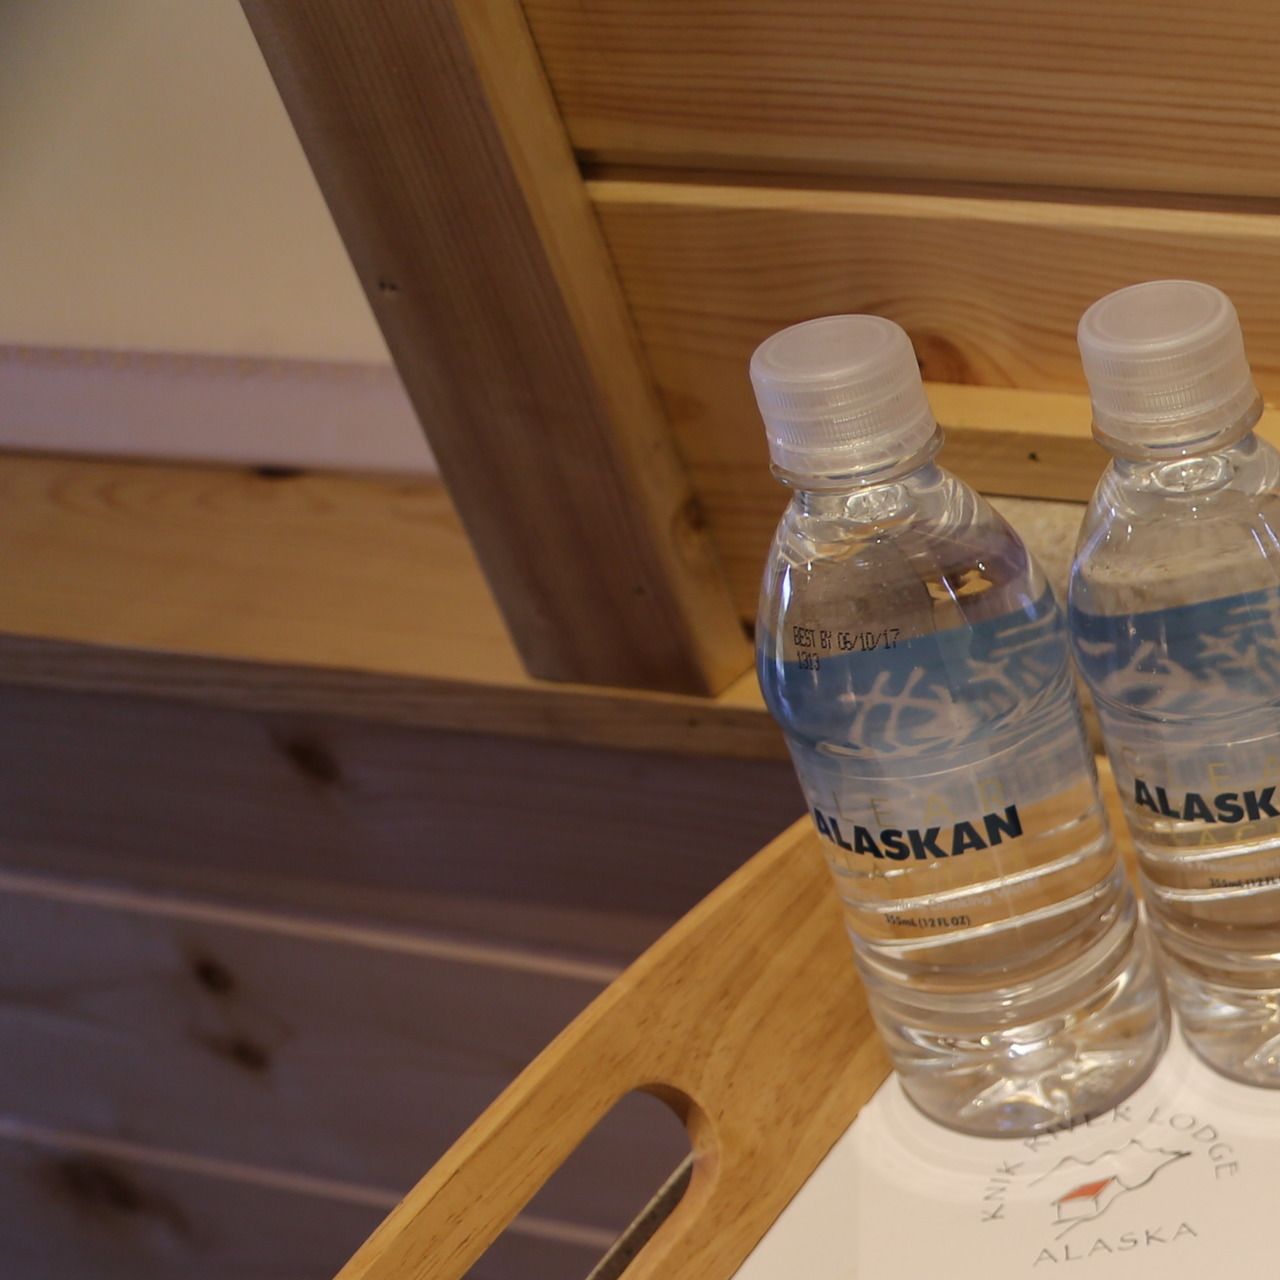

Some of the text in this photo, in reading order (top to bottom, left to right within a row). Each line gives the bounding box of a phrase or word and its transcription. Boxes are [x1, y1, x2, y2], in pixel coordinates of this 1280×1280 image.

[793, 626, 816, 649] BEST
[820, 630, 832, 650] BY
[813, 804, 1024, 861] ALASKAN
[981, 1161, 1025, 1222] KNIK
[1149, 1106, 1239, 1180] LODGE
[1032, 1221, 1198, 1267] ALASKA
